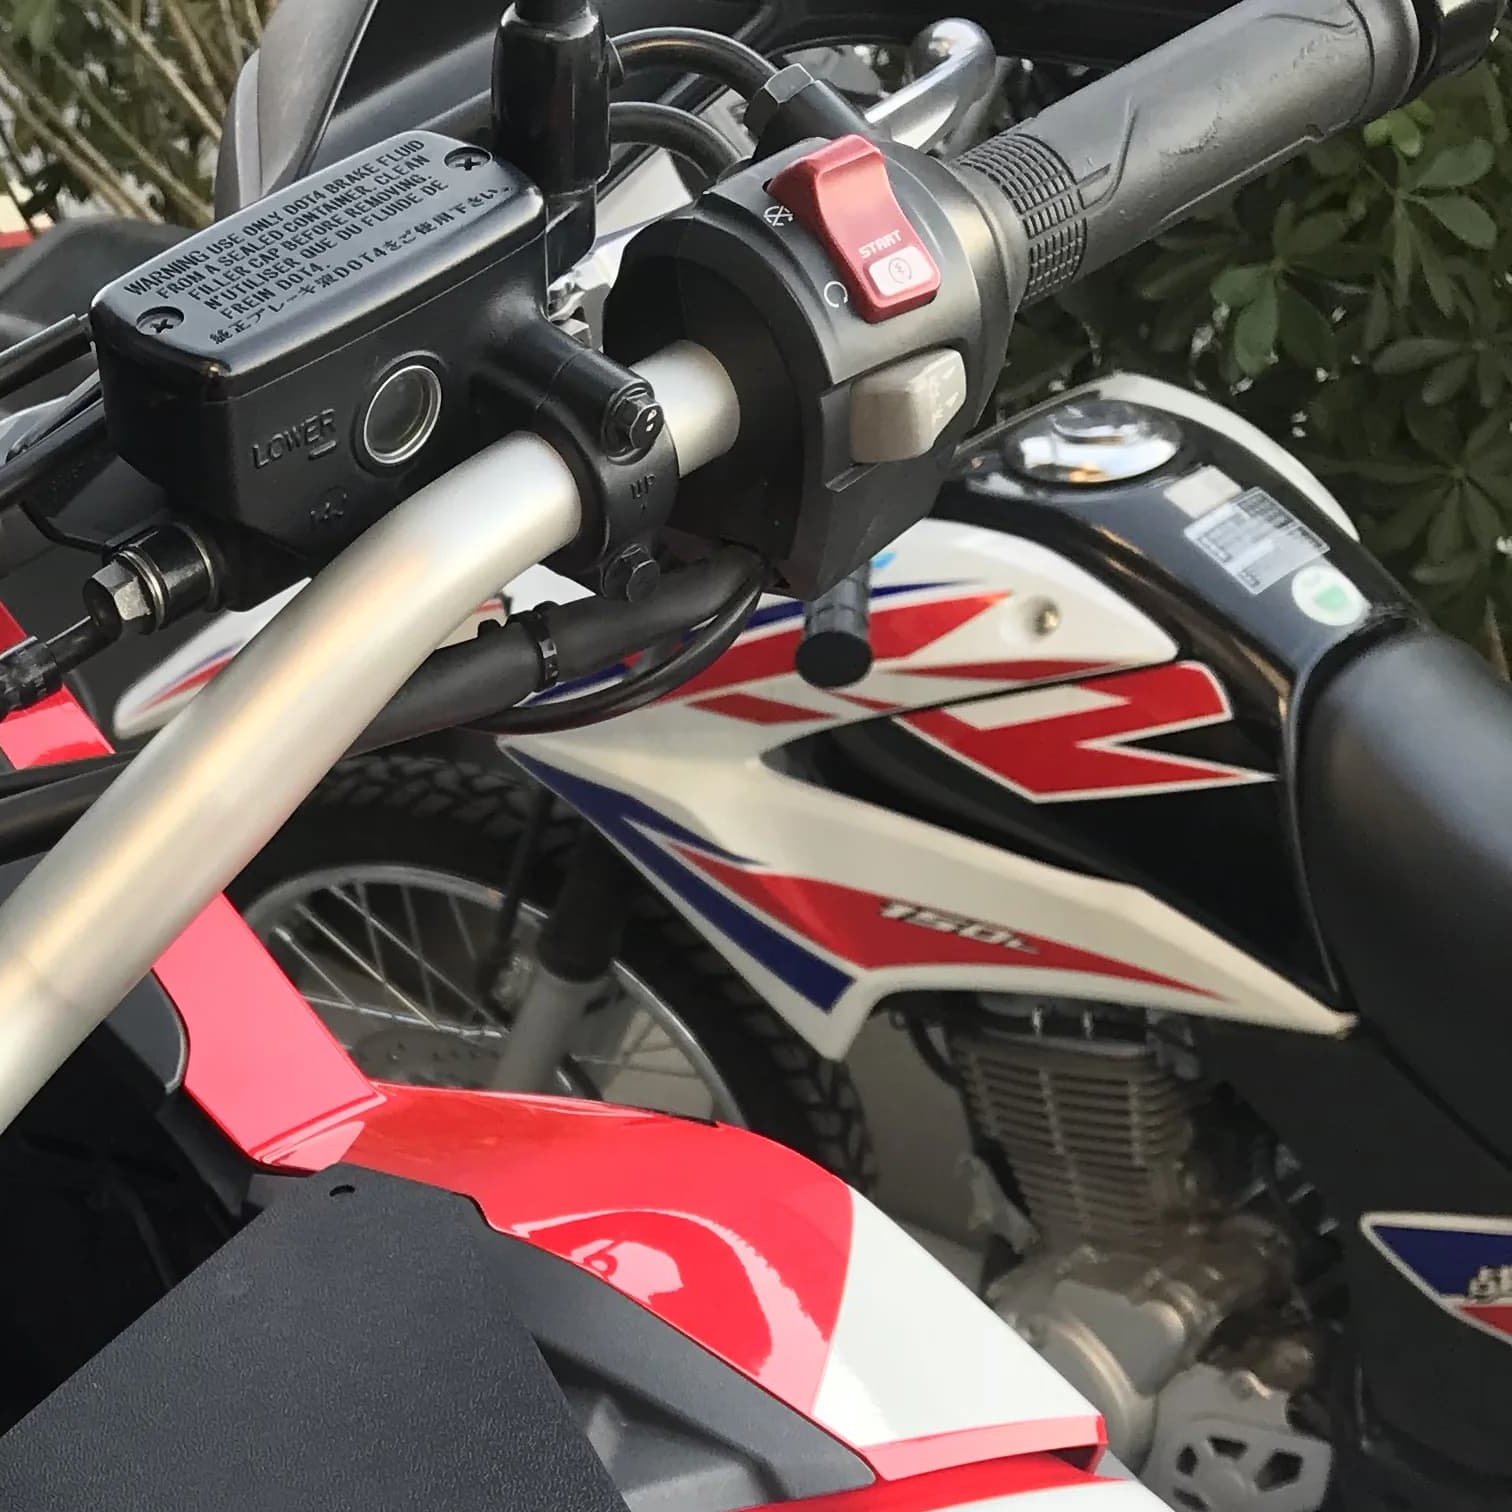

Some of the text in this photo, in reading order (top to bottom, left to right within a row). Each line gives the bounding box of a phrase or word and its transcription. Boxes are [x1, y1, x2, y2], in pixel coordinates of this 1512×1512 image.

[124, 139, 425, 296] WARNING USE ONLY DOT4 BRAKE FLUID
[155, 154, 431, 300] FROM A SEALED CONTAINER. CLEAN
[187, 174, 433, 301] FILLER CAP BEFORE REMOVING.
[203, 178, 450, 310] N'UTILISER QUE DU FLUIDE DE
[857, 229, 902, 260] START
[220, 262, 332, 321] FREIN DOT4.
[251, 407, 336, 470] LOWER
